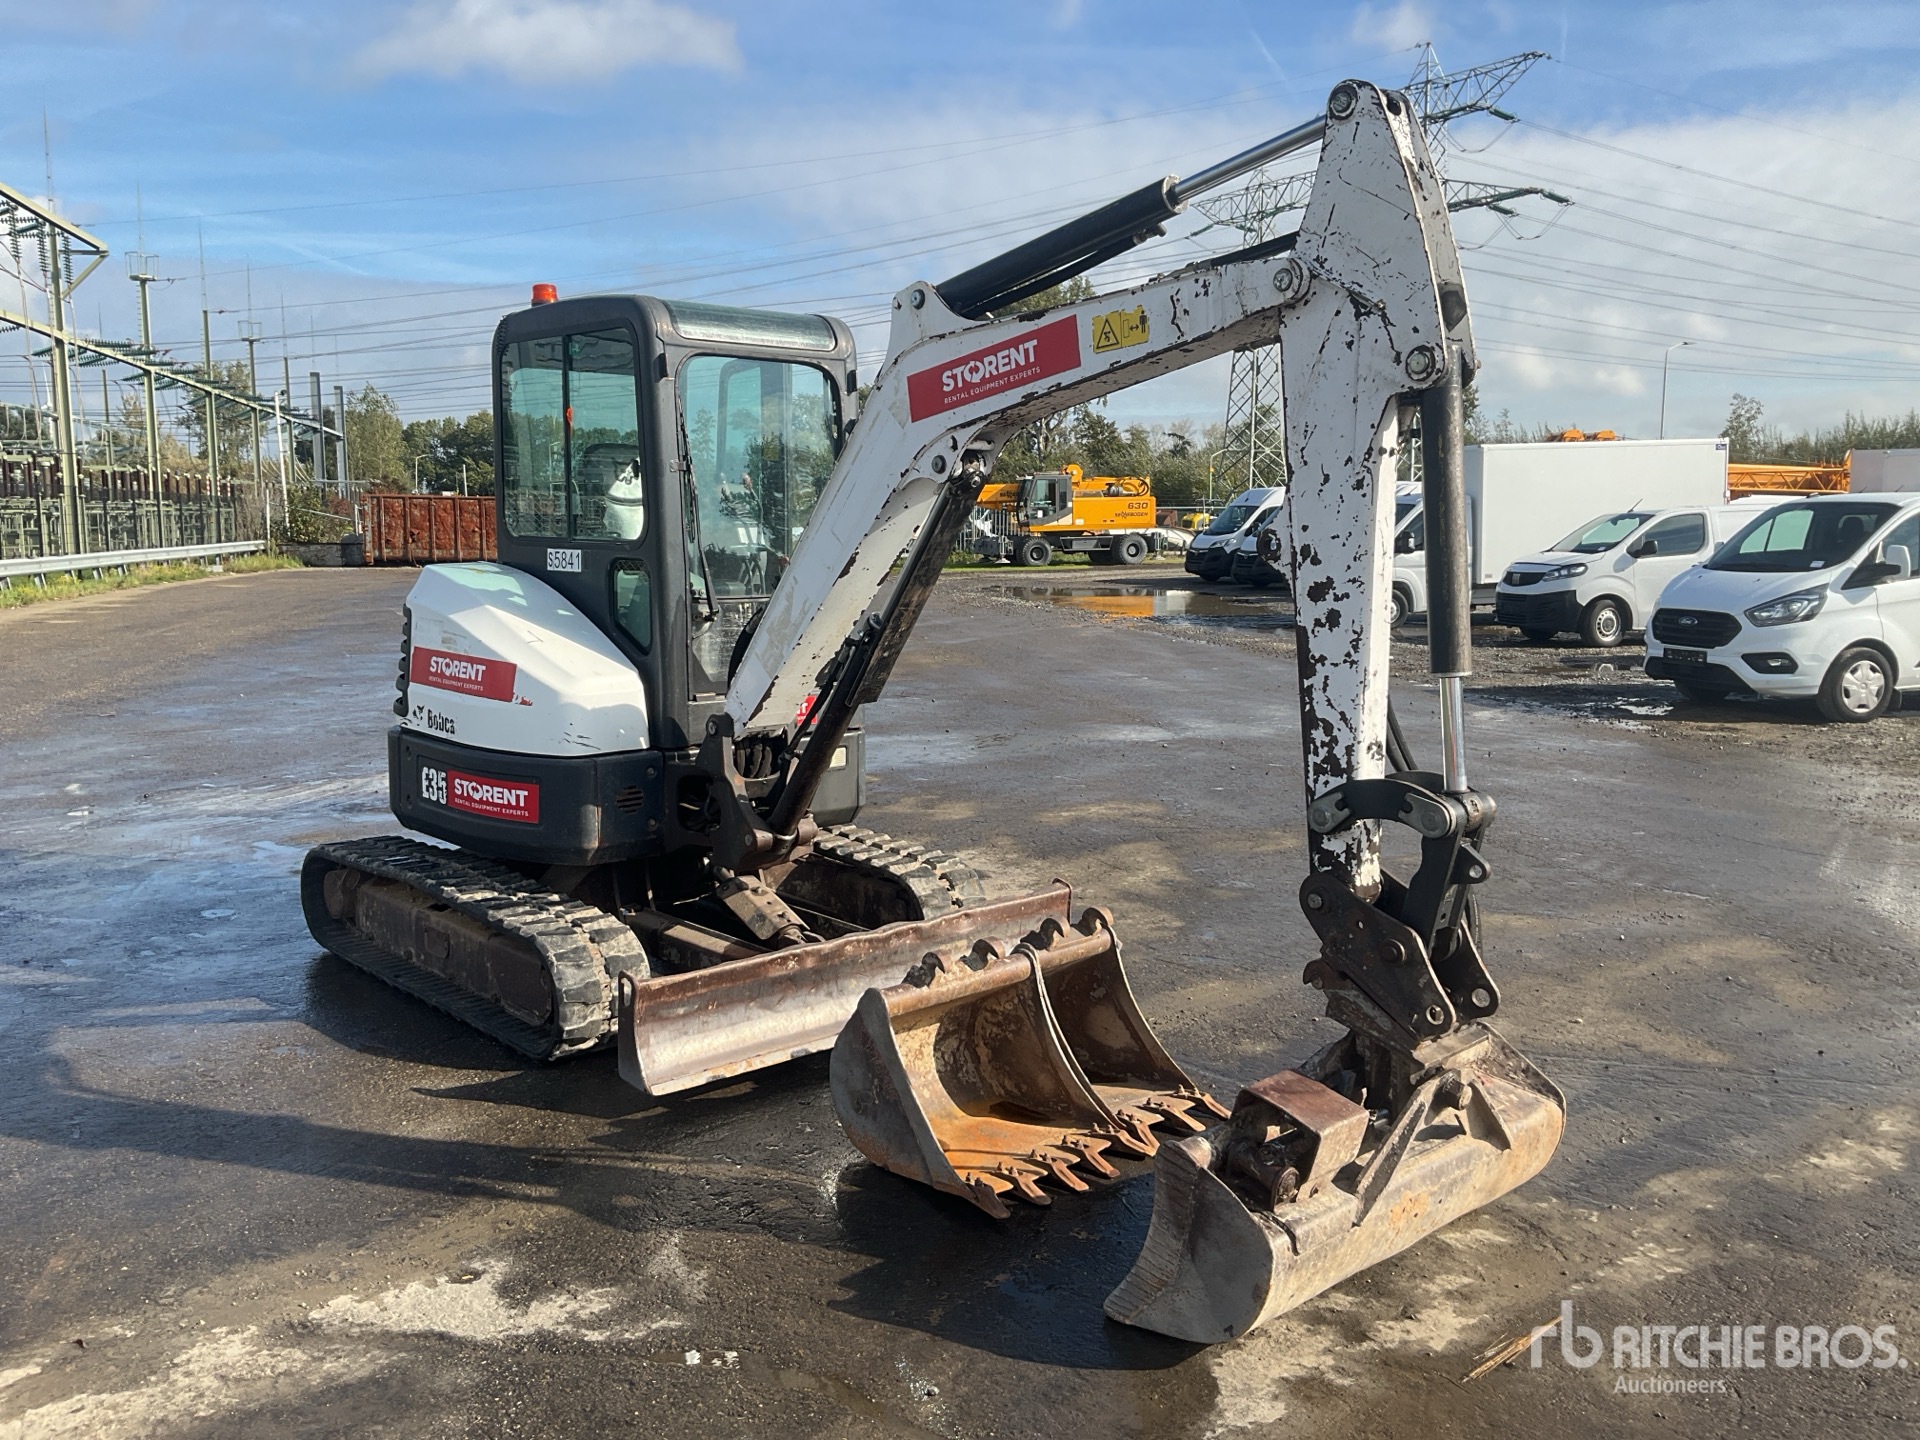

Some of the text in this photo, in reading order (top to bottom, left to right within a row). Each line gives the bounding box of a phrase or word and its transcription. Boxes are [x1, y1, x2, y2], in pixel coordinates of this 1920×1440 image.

[942, 339, 1038, 392] STORENT
[944, 366, 1040, 404] RENTAL EQUIPMENT EXPERTS
[1128, 502, 1149, 510] 630
[548, 551, 580, 570] S5841
[429, 656, 486, 682] STORENT
[428, 675, 484, 691] RENTAL EQUIPMENT EXPERTS
[421, 766, 448, 805] E35
[454, 778, 529, 807] STORENT
[454, 797, 529, 817] RENTAL EQUIPMENT EXPERTS
